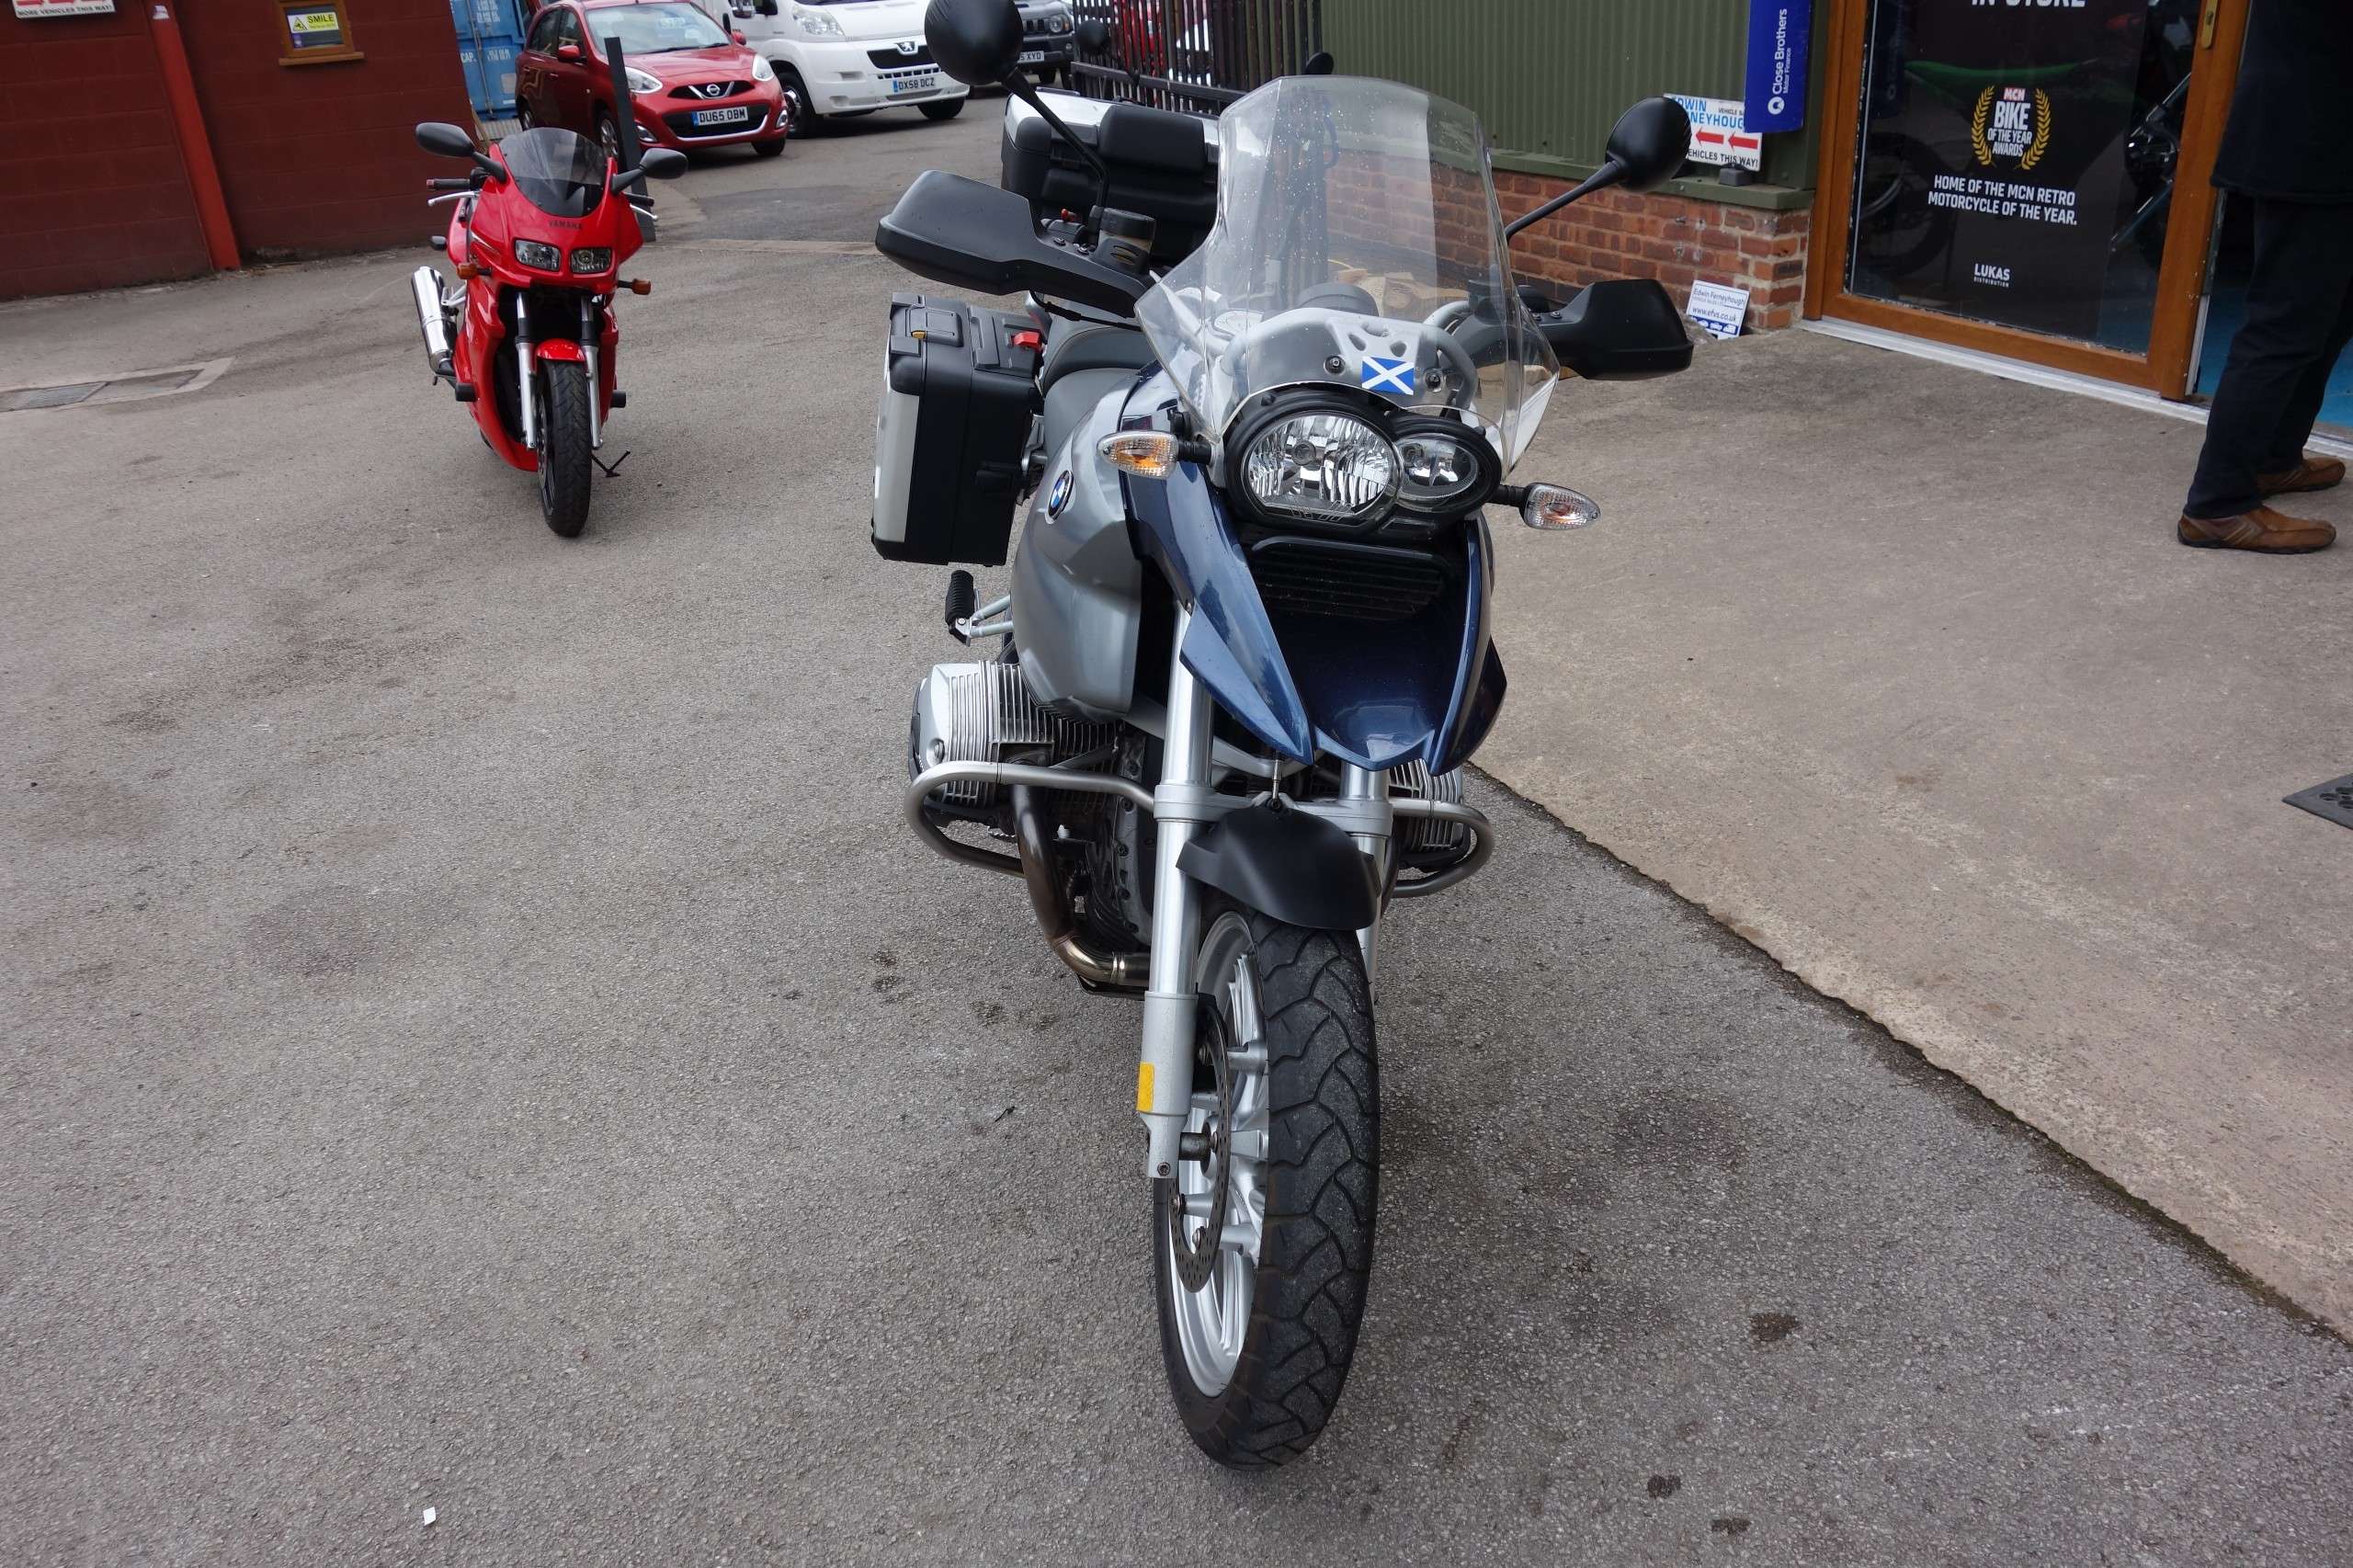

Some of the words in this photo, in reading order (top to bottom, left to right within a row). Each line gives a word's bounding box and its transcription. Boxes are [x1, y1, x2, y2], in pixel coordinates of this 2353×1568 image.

[307, 15, 334, 23] SMILE
[1774, 8, 1788, 60] Brothers
[898, 79, 918, 90] DX58
[920, 77, 935, 87] DCZ
[1772, 62, 1784, 95] Close
[2004, 87, 2026, 101] MCN
[1677, 97, 1707, 112] DWIN
[699, 110, 724, 123] DU65
[1994, 100, 2031, 131] BIKE
[1987, 129, 1997, 141] OF
[1997, 129, 2011, 142] THE
[2012, 130, 2033, 145] YEAR
[1992, 142, 2024, 157] AWARDS
[1688, 149, 1718, 161] EHICLES
[1721, 153, 1737, 165] THIS
[1740, 157, 1758, 168] WAY!
[1934, 175, 1966, 192] HOME
[1968, 179, 1984, 194] OF
[1984, 181, 2005, 198] THE
[2007, 184, 2035, 201] MCN
[2037, 187, 2075, 207] RETRO
[1928, 191, 2000, 214] MOTORCYCLE
[2001, 201, 2018, 216] OF
[2019, 203, 2042, 221] THE
[2043, 207, 2077, 226] YEAR.
[550, 221, 582, 230] YAMAHA
[1974, 263, 2010, 281] LUKAS
[1973, 277, 2009, 288] DISTRIBUTION
[1693, 288, 1711, 297] Edwin
